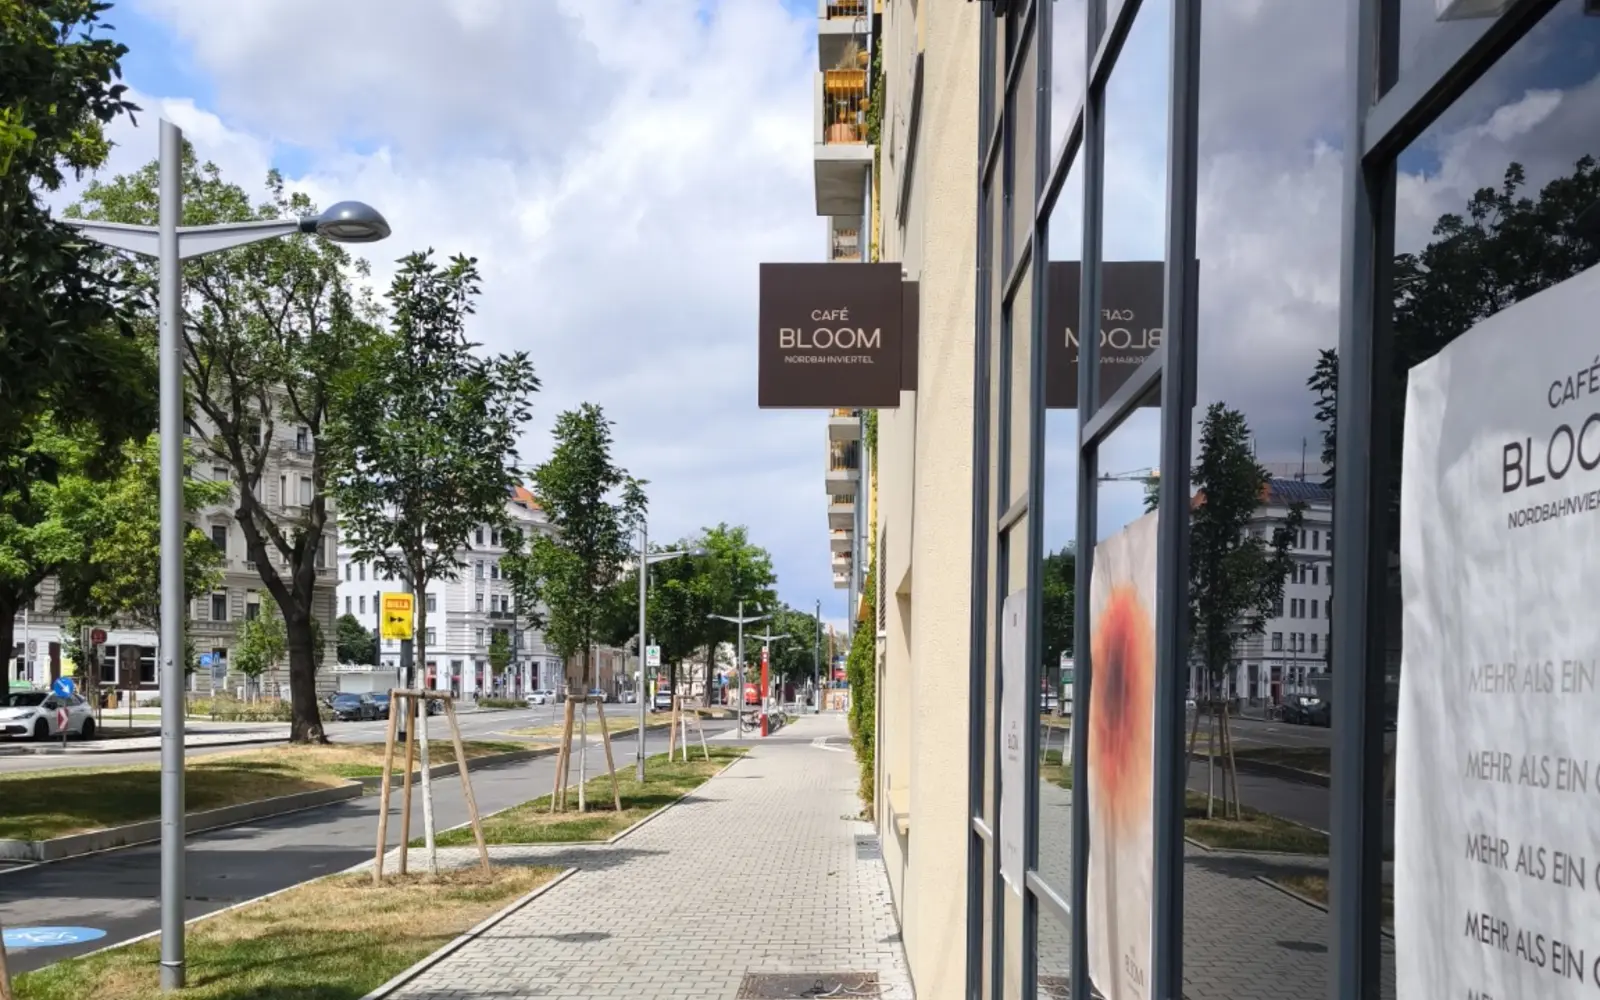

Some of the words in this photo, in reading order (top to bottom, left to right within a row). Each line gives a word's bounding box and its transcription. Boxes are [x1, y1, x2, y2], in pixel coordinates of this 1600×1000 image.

[811, 306, 849, 321] CAFÉ
[780, 327, 881, 349] BLOOM
[784, 355, 874, 364] NORDBAHNVIERTEL
[1548, 354, 1600, 409] CAFÉ
[1468, 662, 1516, 694] MEHR
[1522, 659, 1554, 693] ALS
[1561, 658, 1596, 693] EIN
[1465, 749, 1512, 784] MEHR
[1518, 755, 1550, 789] ALS
[1556, 757, 1588, 793] EIN
[1465, 832, 1509, 871] MEHR
[1515, 842, 1547, 880] ALS
[1553, 851, 1585, 890] EIN
[1465, 909, 1509, 952] MEHR
[1516, 928, 1546, 968] ALS
[1552, 940, 1584, 984] EIN
